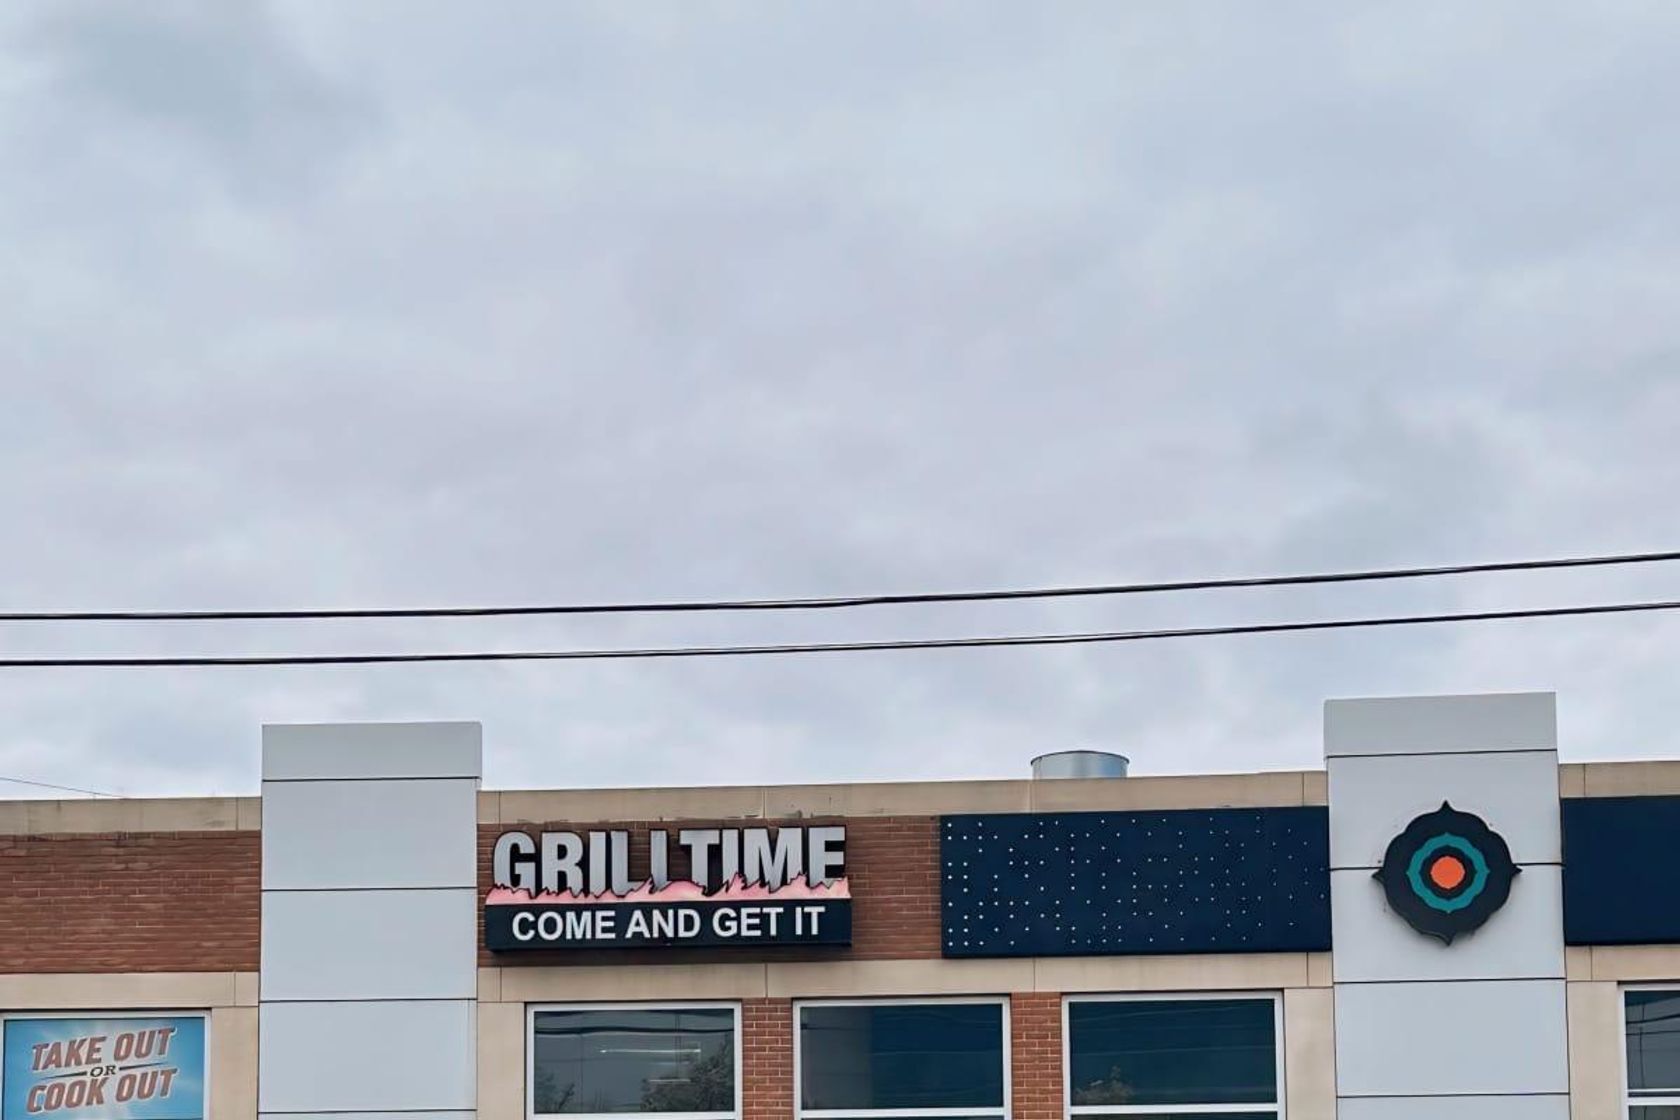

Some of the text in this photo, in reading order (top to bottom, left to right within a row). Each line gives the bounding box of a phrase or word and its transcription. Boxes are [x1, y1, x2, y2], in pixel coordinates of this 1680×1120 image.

[511, 906, 826, 941] COME AND GET IT
[31, 1027, 177, 1071] TAKE OUT
[26, 1068, 178, 1114] COOK OUT
[90, 1065, 117, 1078] OR
